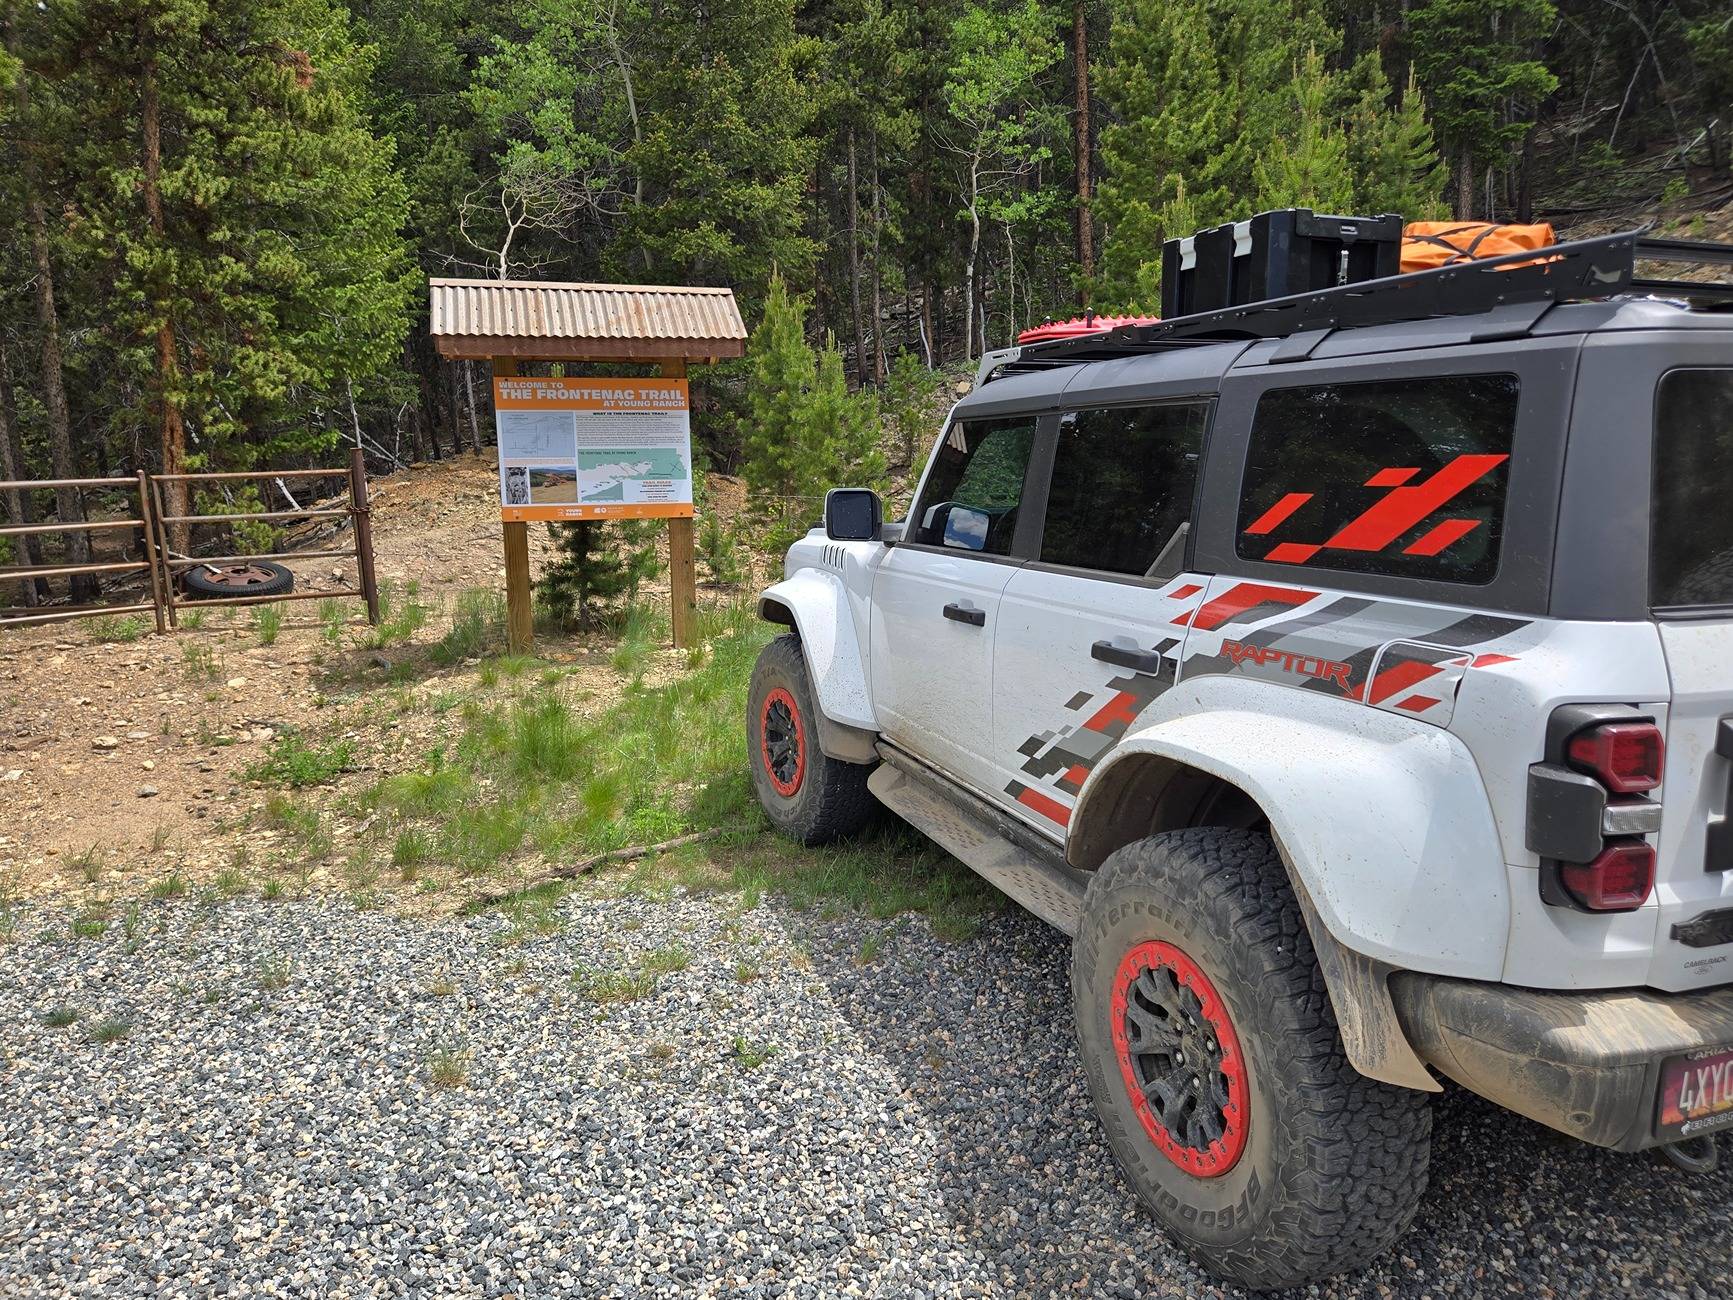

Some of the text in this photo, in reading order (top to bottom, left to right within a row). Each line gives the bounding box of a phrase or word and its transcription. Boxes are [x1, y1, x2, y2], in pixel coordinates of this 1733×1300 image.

[498, 381, 549, 389] WELCOME
[499, 388, 685, 400] THE FRONTENAC TRAIL
[1219, 638, 1353, 697] RAPTOR
